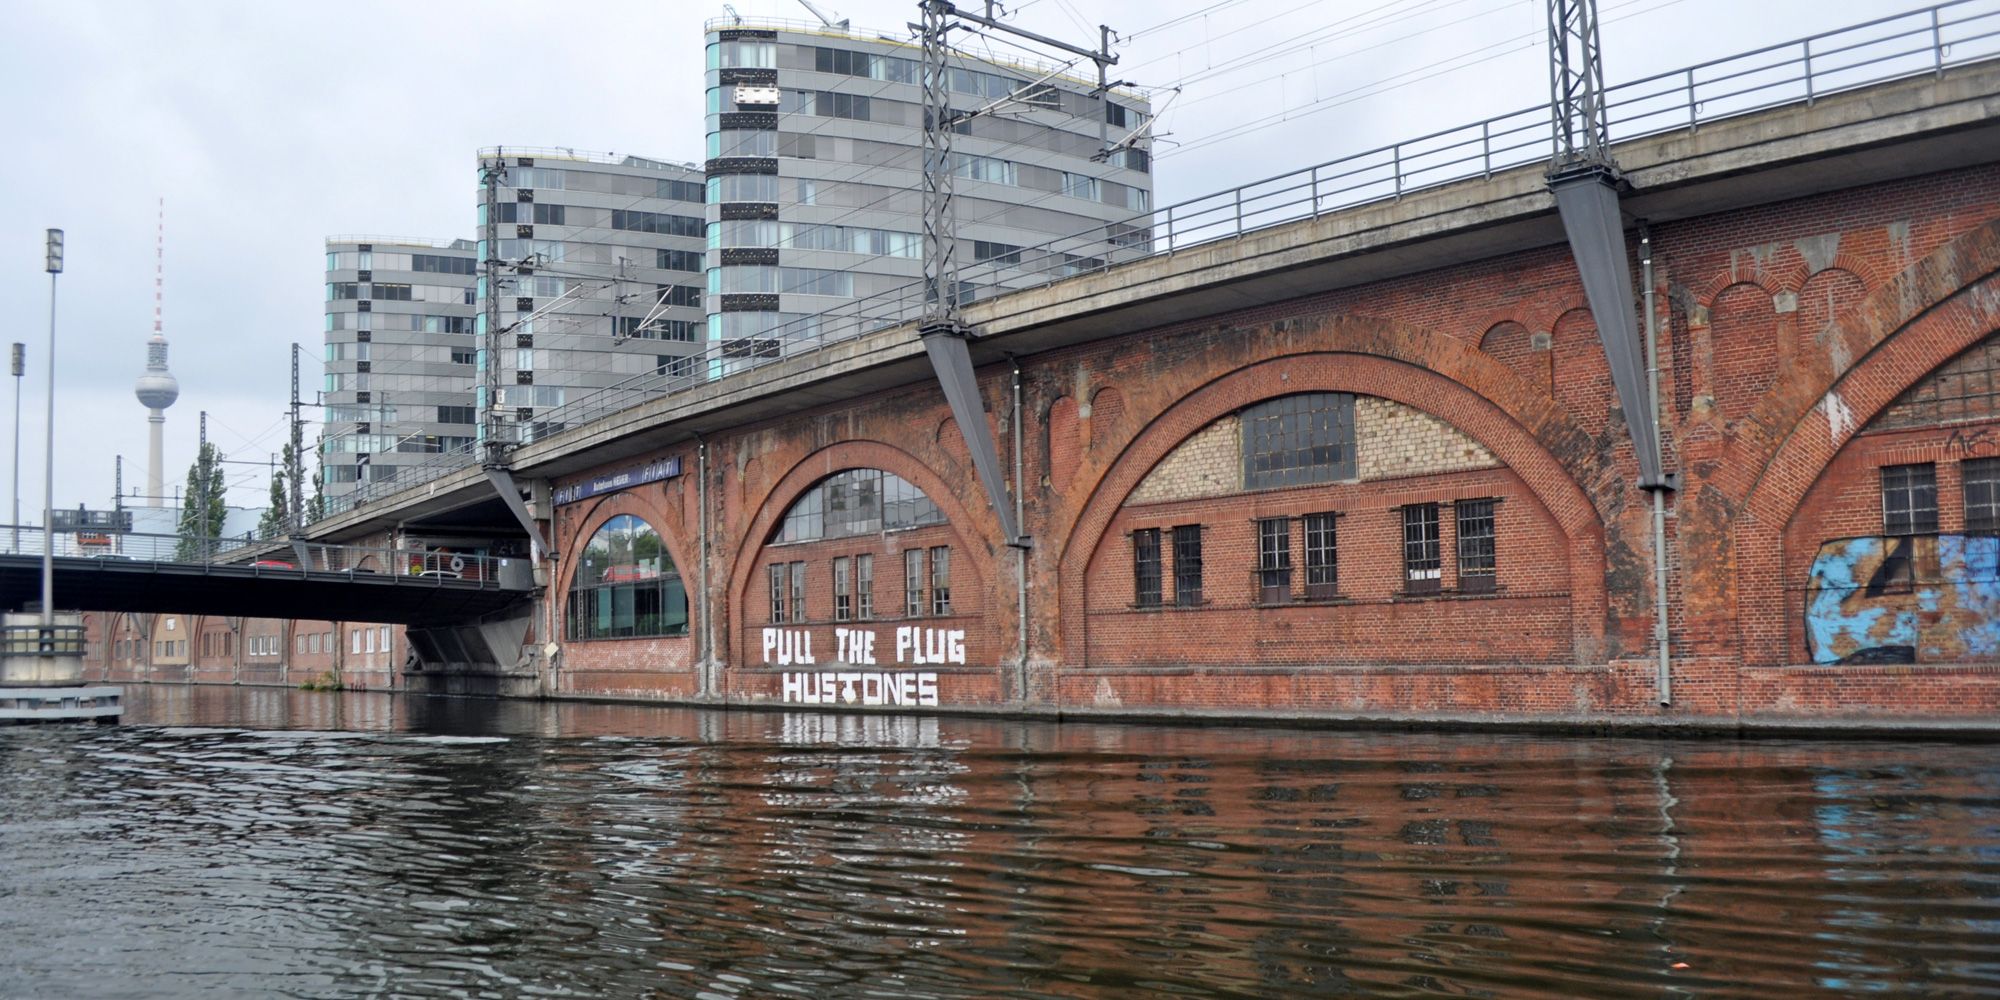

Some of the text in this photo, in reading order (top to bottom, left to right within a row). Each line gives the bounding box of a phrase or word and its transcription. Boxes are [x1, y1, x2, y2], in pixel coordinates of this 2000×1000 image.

[558, 486, 581, 504] FIT
[643, 462, 672, 481] FIAT
[763, 626, 966, 665] PULL THE PLUG
[783, 672, 939, 707] HUSTONES
